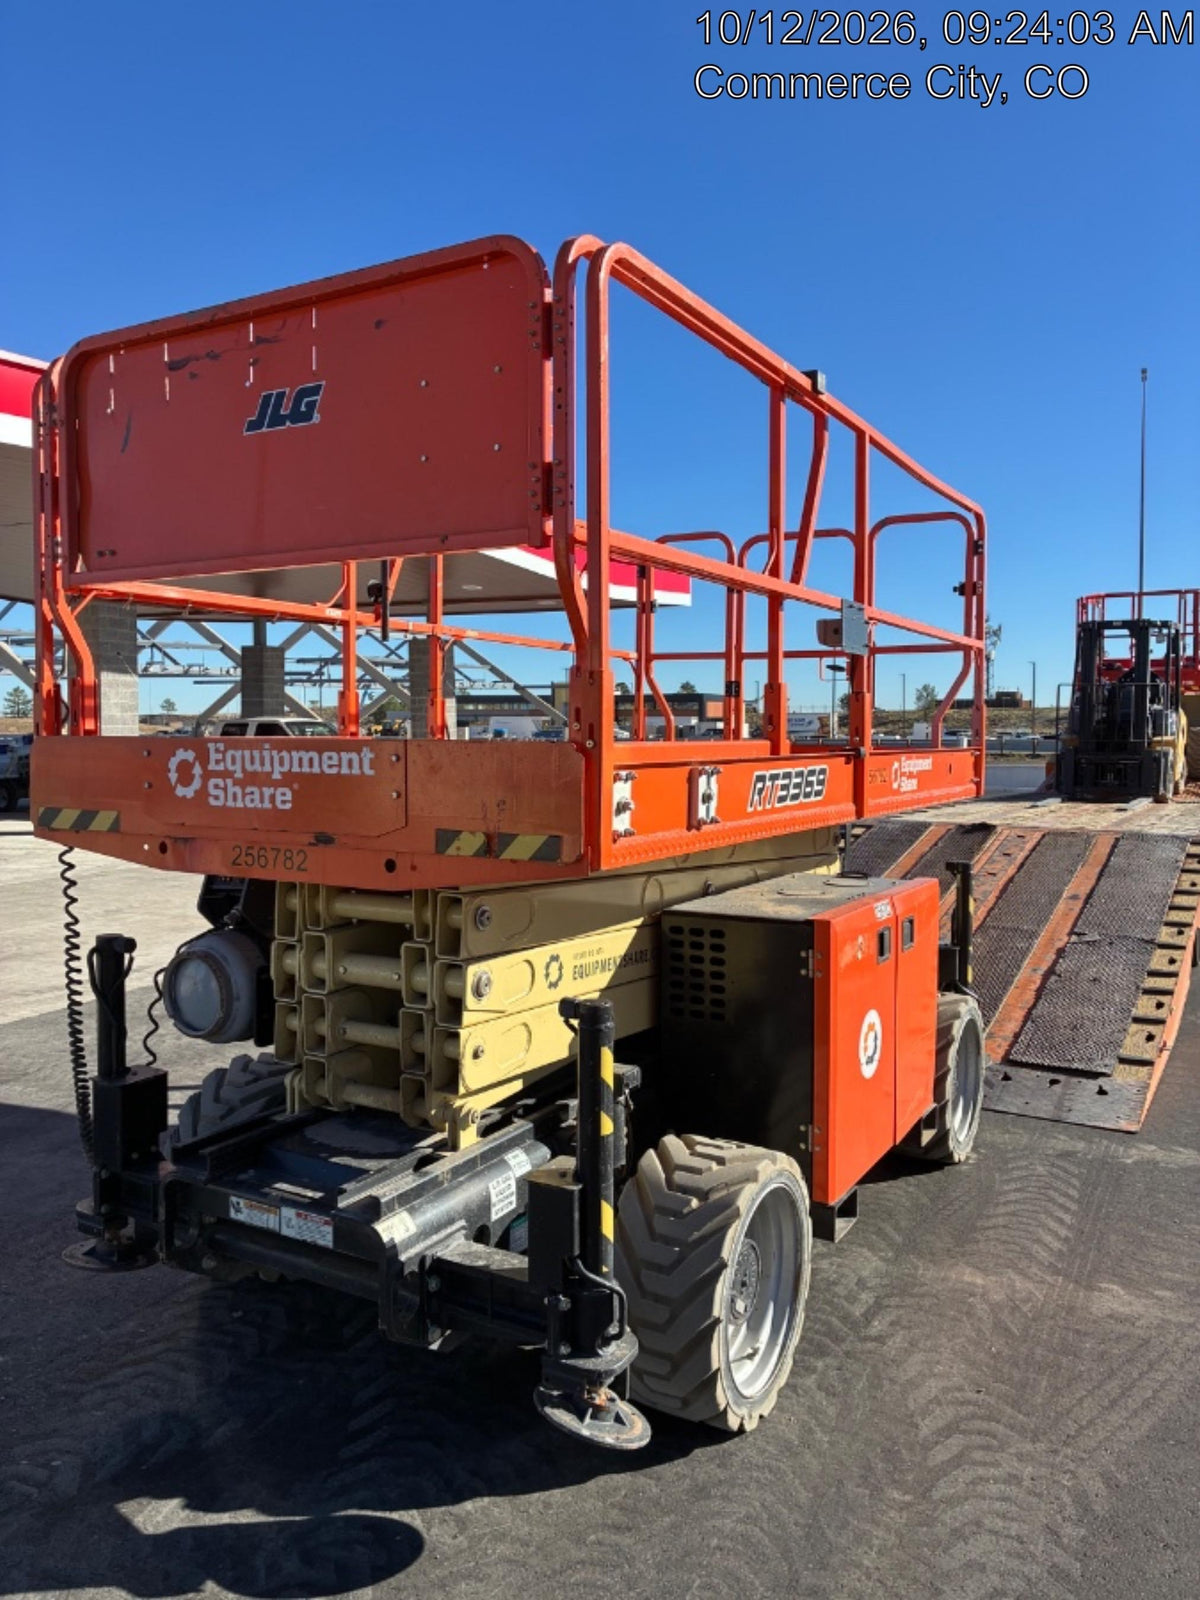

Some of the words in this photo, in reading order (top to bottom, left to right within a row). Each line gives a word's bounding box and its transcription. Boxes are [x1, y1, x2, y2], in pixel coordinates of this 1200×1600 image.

[243, 380, 326, 436] JLG
[207, 742, 375, 779] Equipment
[207, 778, 292, 810] Share
[746, 764, 829, 813] RT3369
[231, 845, 308, 872] 256782
